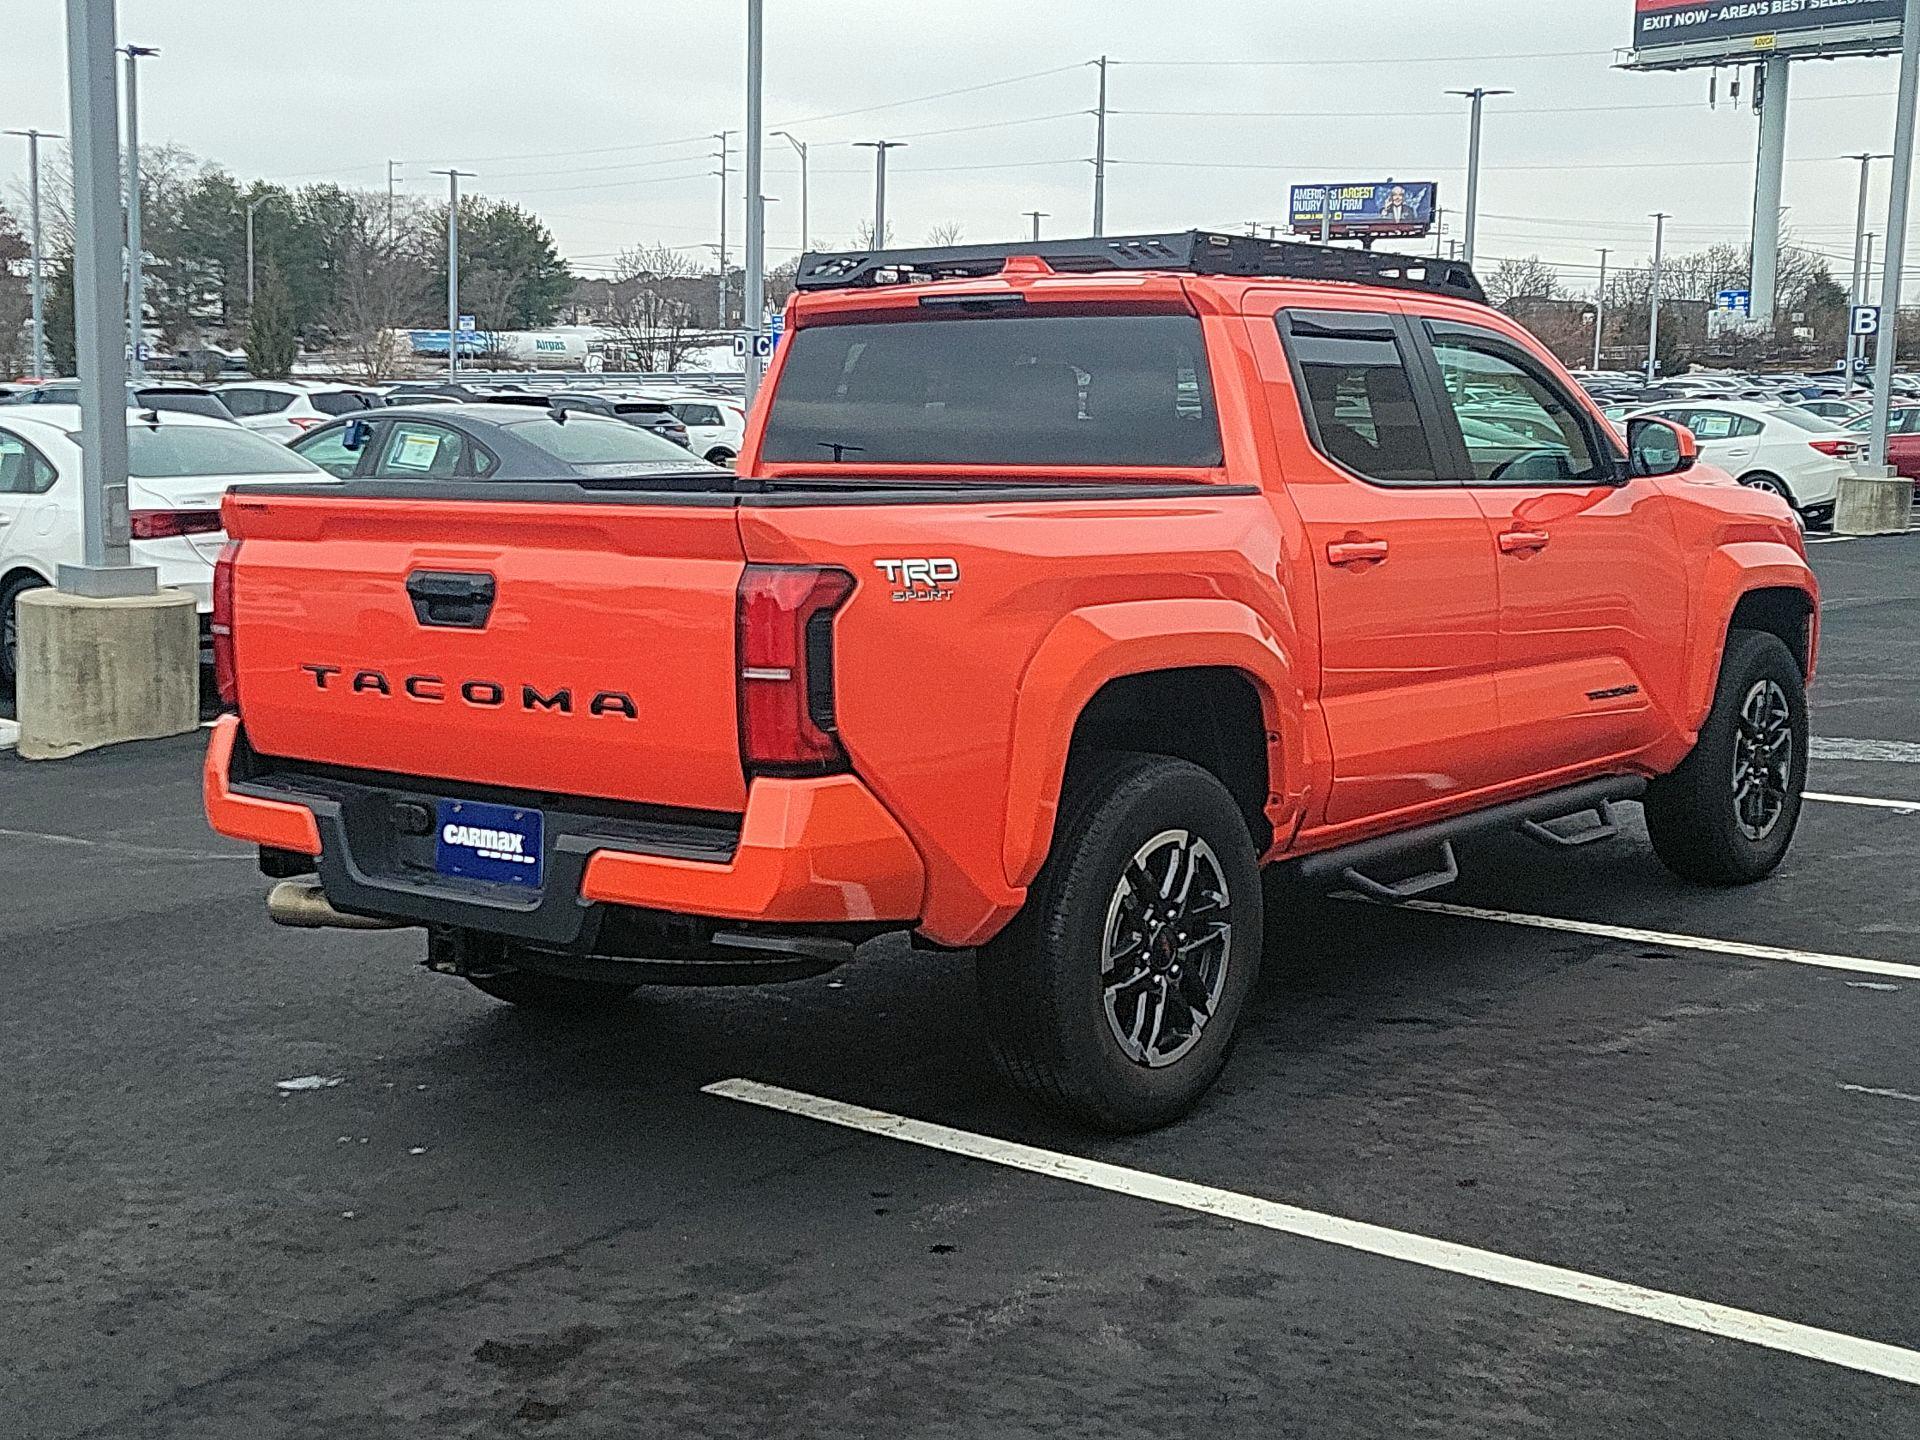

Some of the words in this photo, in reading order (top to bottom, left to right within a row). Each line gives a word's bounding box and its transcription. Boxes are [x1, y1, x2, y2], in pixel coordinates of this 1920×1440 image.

[1642, 14, 1673, 31] EXIT
[1673, 9, 1710, 27] NOW
[1717, 1, 1769, 21] AREA'S
[1770, 0, 1806, 15] BEST
[1294, 188, 1337, 200] AMERIC'S
[1339, 187, 1375, 199] LARGEST
[1293, 199, 1322, 211] INJURY
[1342, 199, 1363, 210] FIRM
[1855, 308, 1877, 334] B
[536, 339, 566, 351] Airgas
[735, 337, 746, 355] D
[757, 337, 769, 356] C
[1654, 360, 1662, 369] E
[1837, 359, 1846, 370] D
[1855, 359, 1864, 370] C
[873, 558, 959, 587] TRD
[892, 590, 954, 602] SPORT
[300, 664, 639, 720] TACOMA
